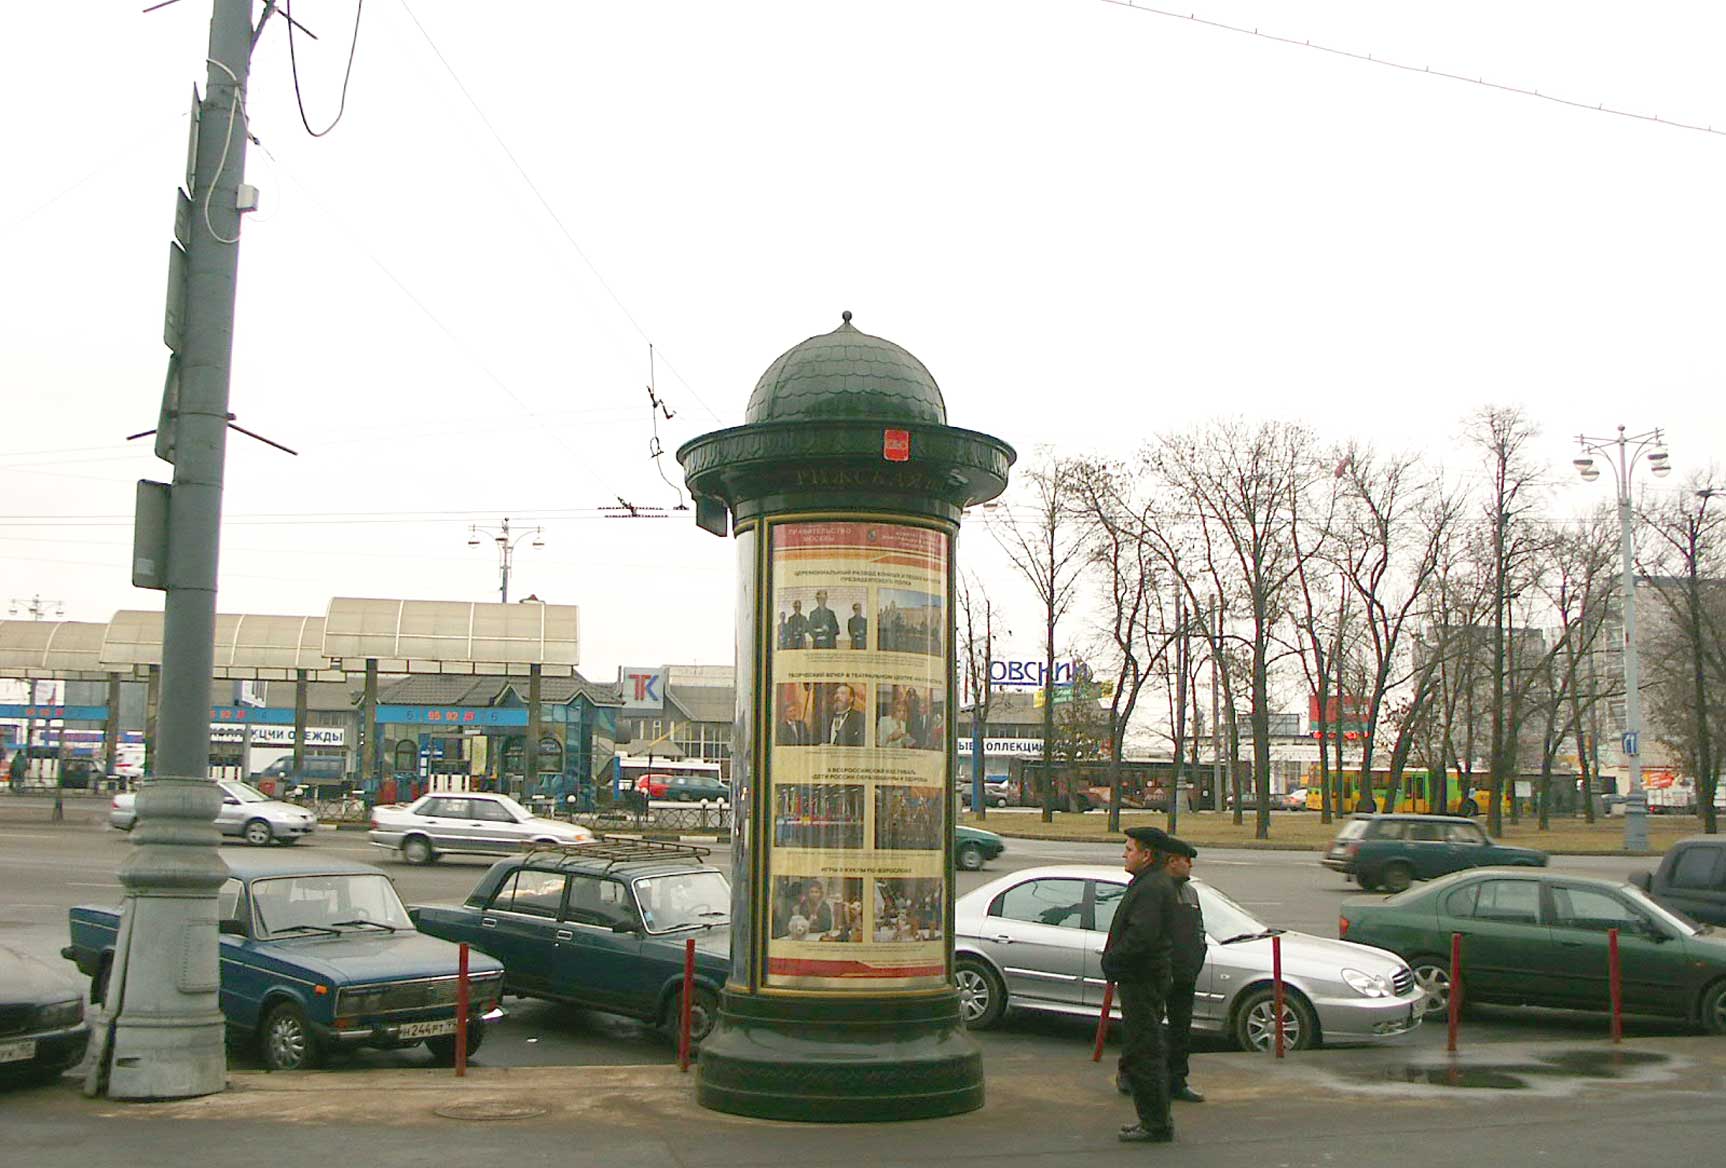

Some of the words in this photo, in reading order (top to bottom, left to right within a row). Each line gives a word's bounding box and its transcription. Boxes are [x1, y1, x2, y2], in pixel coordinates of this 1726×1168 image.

[210, 728, 284, 739] КОЛЛКЦИИ
[287, 730, 343, 743] ОЕЖДЫ
[983, 741, 1044, 753] ОЛЛЕКЦИ
